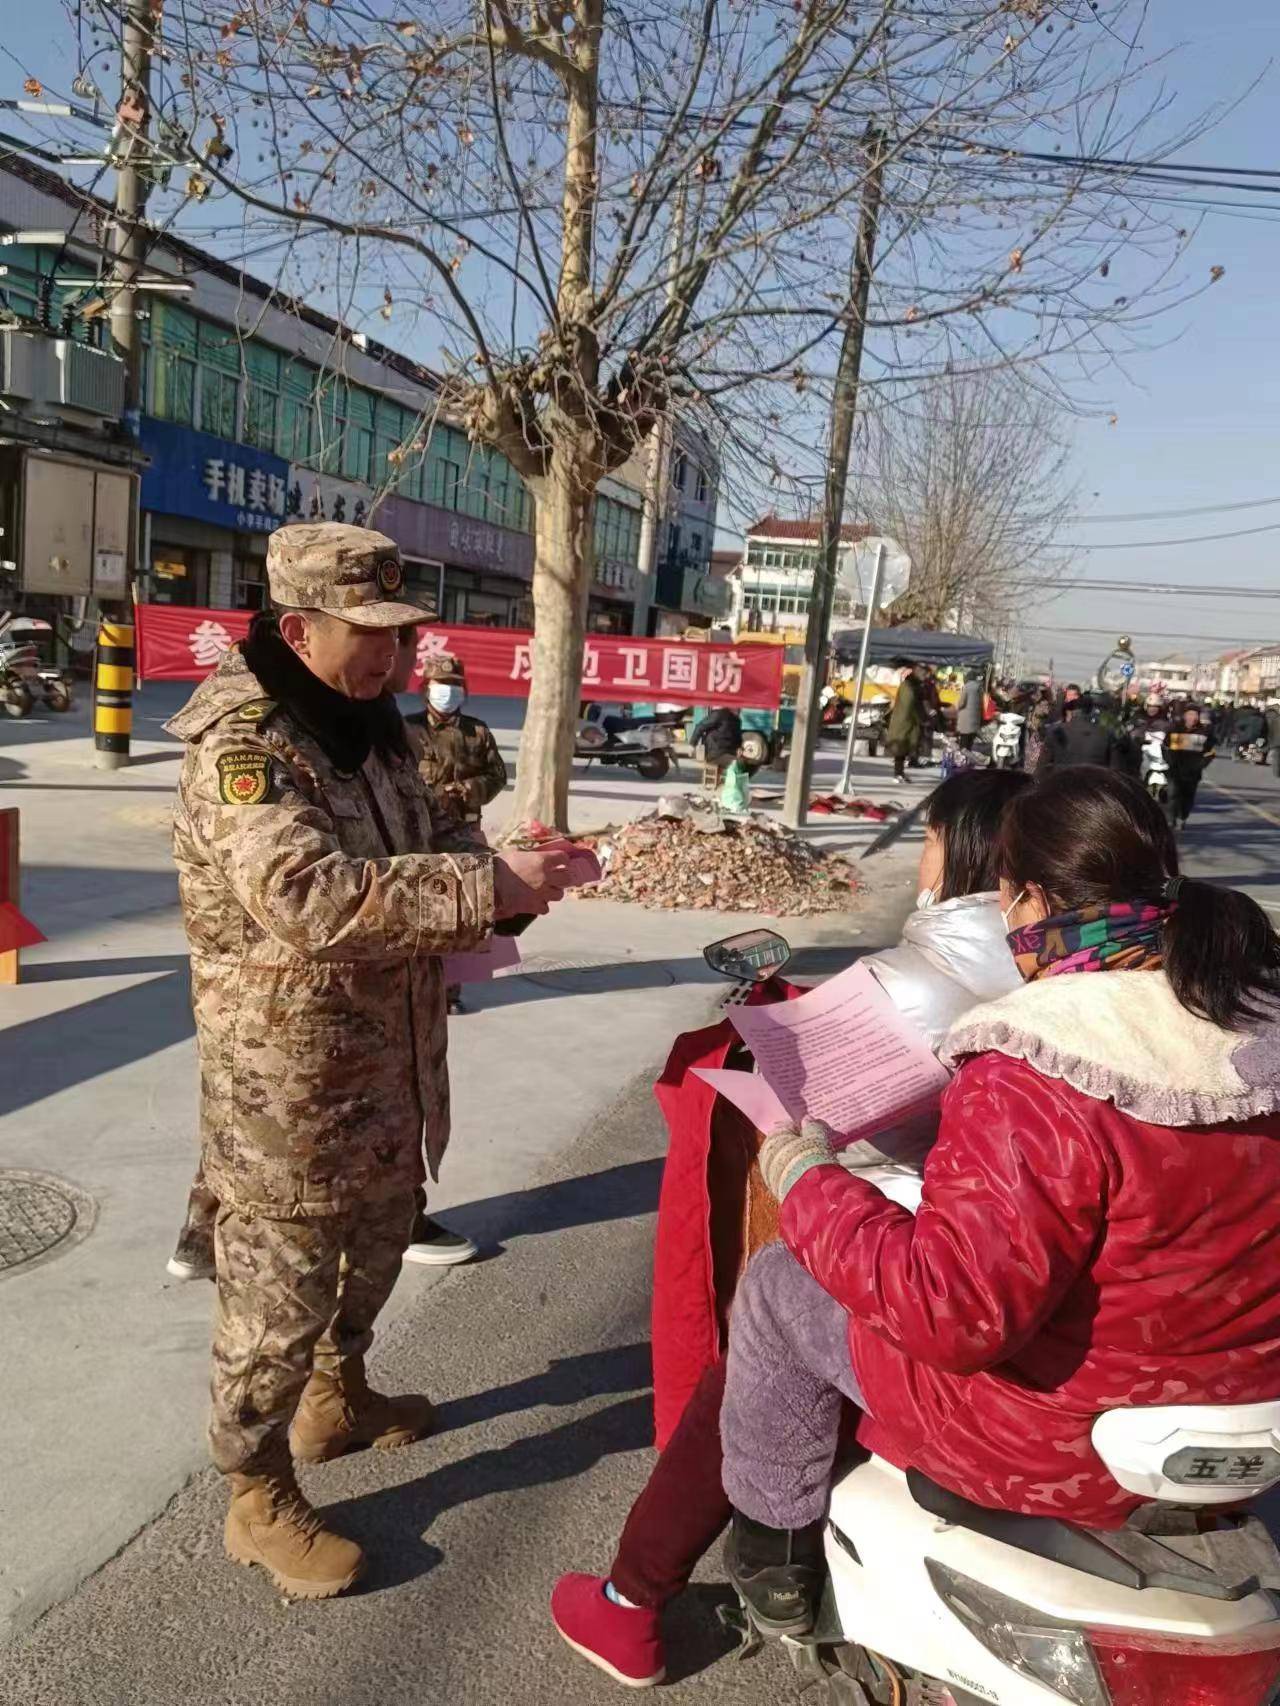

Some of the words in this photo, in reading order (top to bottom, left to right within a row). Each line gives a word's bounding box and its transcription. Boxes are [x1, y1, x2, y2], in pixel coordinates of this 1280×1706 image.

[203, 458, 286, 518] 手机卖场
[1184, 1455, 1264, 1480] 五羊
